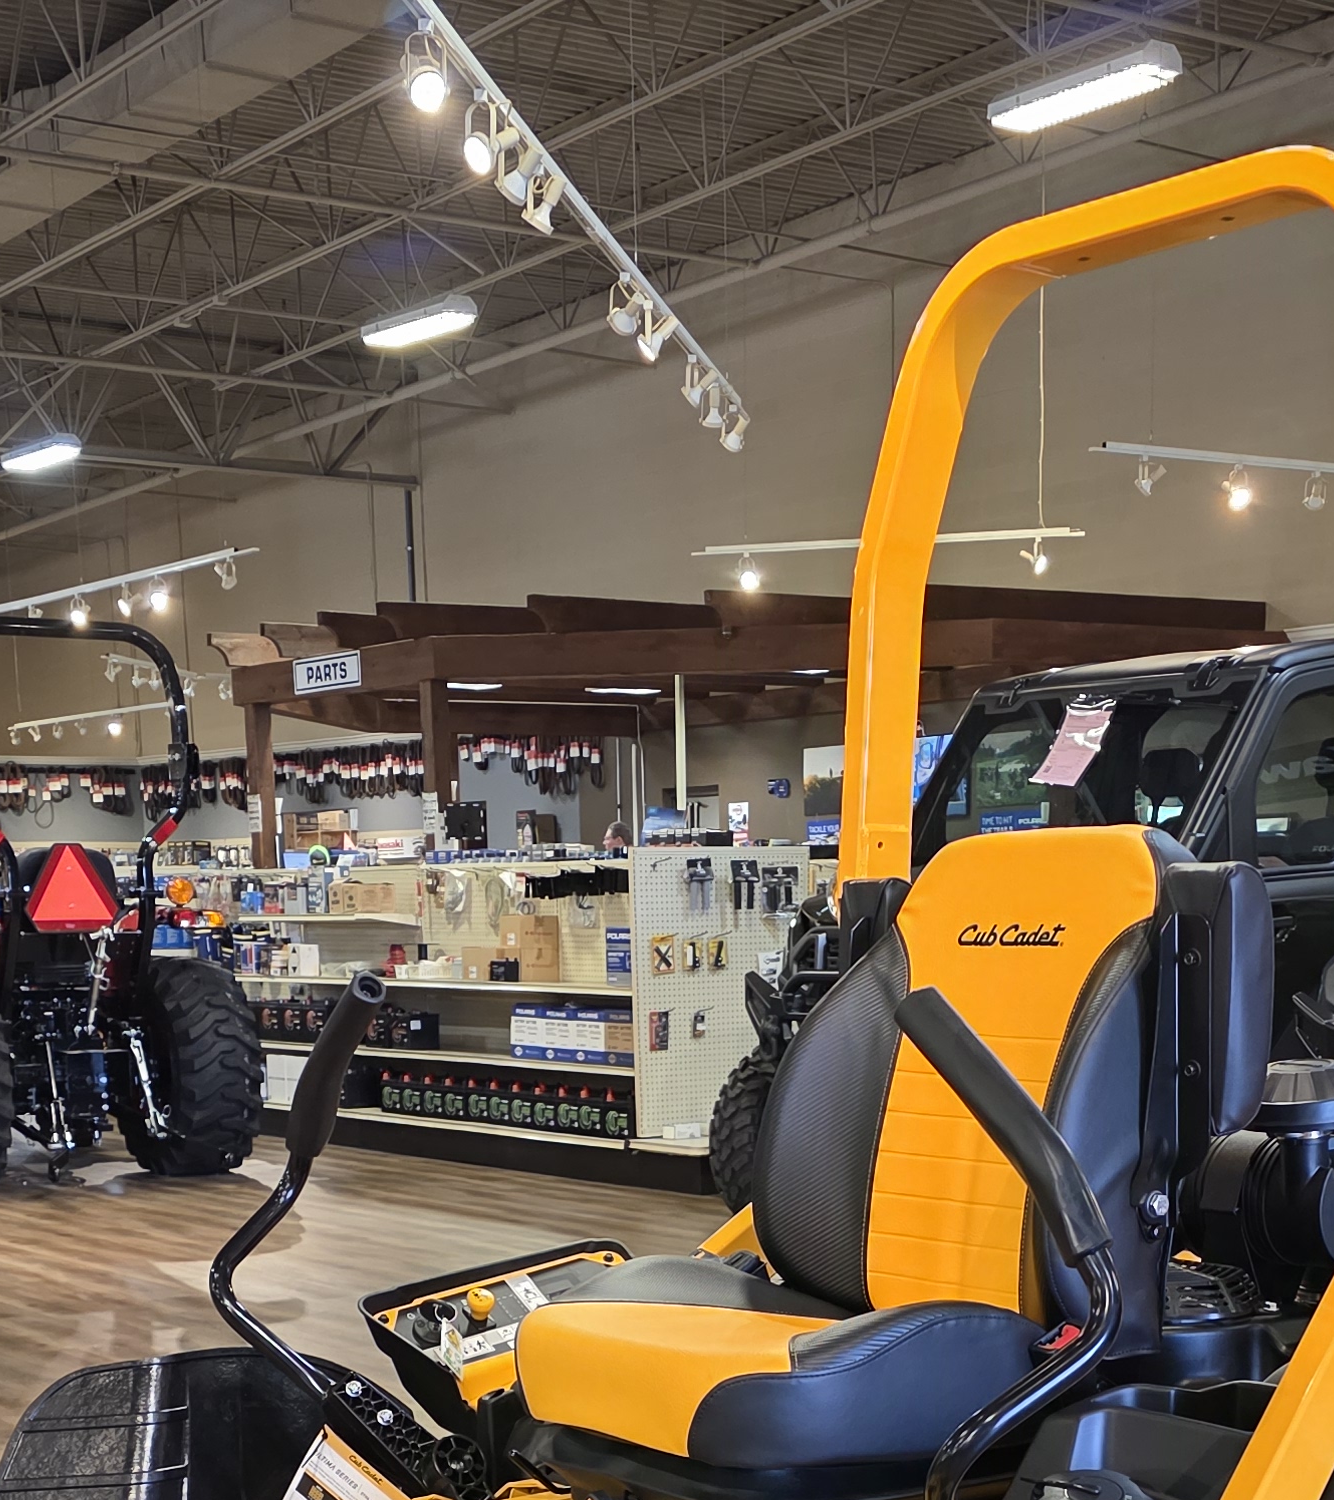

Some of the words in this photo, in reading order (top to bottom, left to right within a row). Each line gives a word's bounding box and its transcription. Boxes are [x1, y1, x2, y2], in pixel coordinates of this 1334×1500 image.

[305, 660, 348, 685] PARTS
[957, 923, 997, 947] Cub
[999, 922, 1066, 947] Cadet
[348, 1454, 363, 1472] Cub
[361, 1465, 385, 1486] Cadet
